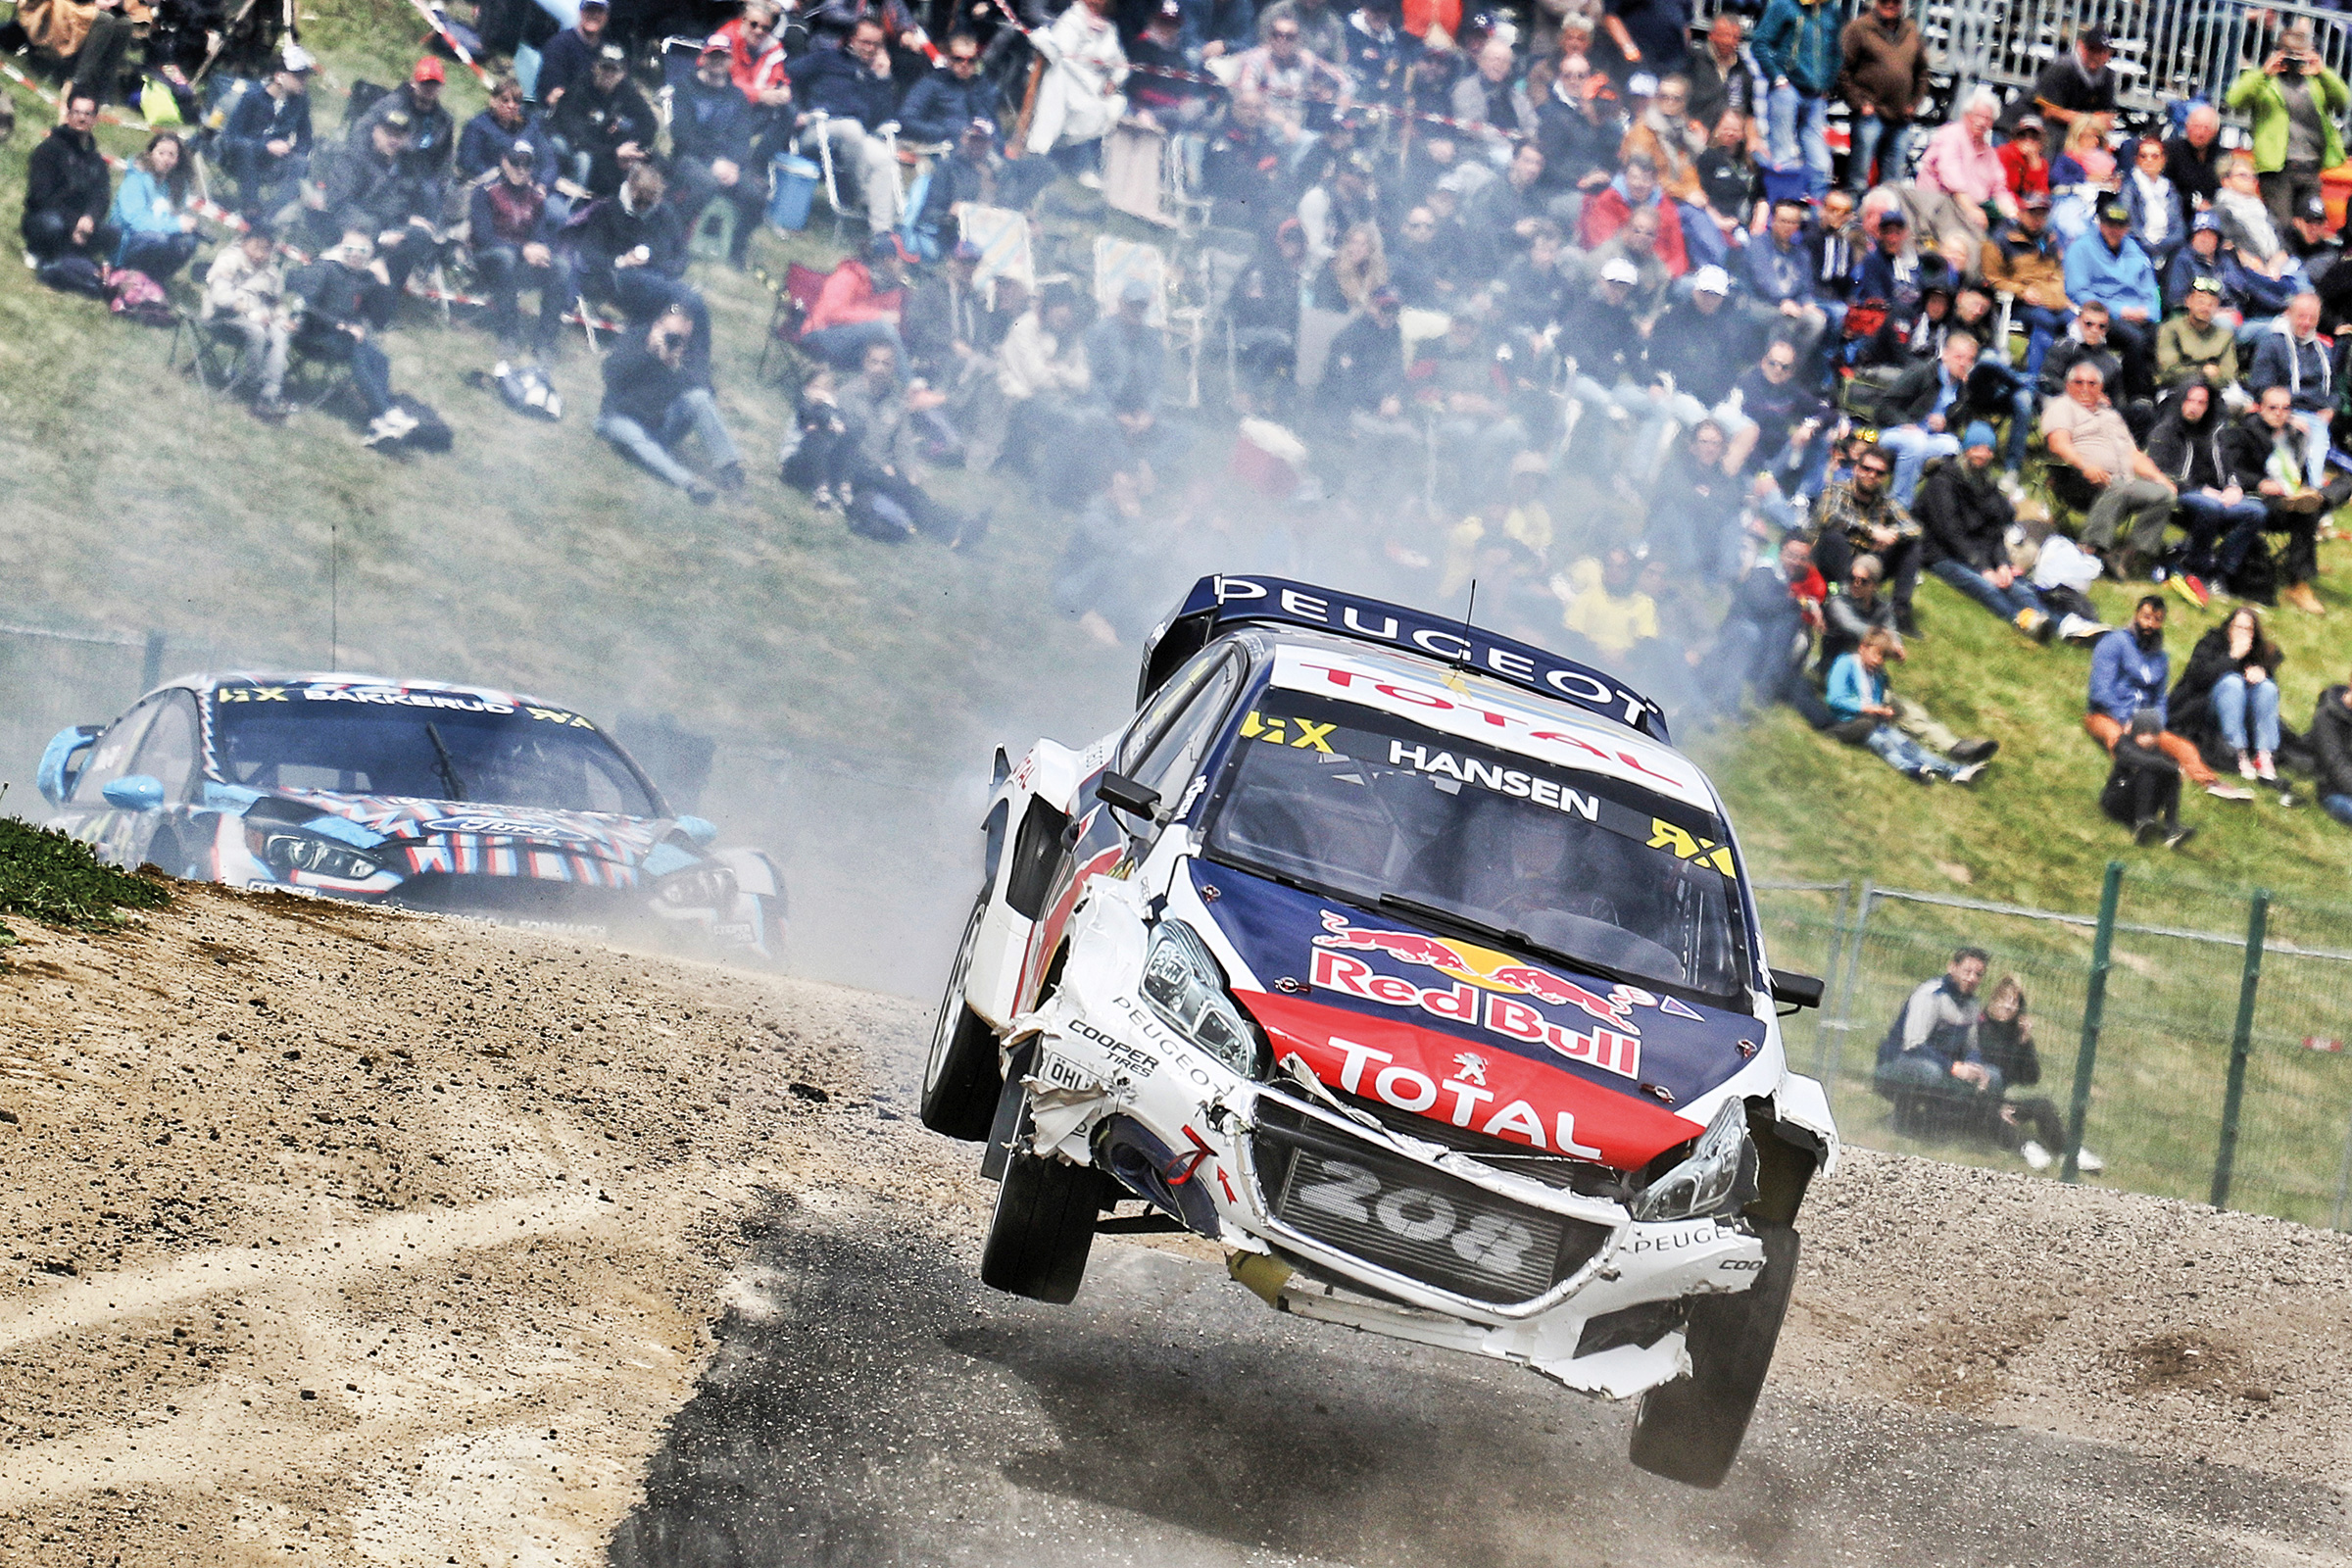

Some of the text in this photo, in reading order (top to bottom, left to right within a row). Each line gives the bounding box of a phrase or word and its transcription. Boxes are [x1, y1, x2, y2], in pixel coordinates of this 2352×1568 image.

[1213, 574, 1658, 726] PEUGEOT
[303, 689, 514, 714] BAKKERUD
[1299, 662, 1684, 789] TOTAL
[1390, 740, 1600, 822] HANSEN
[459, 817, 559, 836] Ford
[1068, 1018, 1160, 1070] COOPER
[1309, 947, 1642, 1080] Red Bull
[1104, 1051, 1153, 1078] TIRES
[1327, 1036, 1602, 1159] TOTAL
[1298, 1160, 1535, 1275] 208
[1635, 1226, 1731, 1254] PEUGE
[1718, 1258, 1763, 1271] COO
